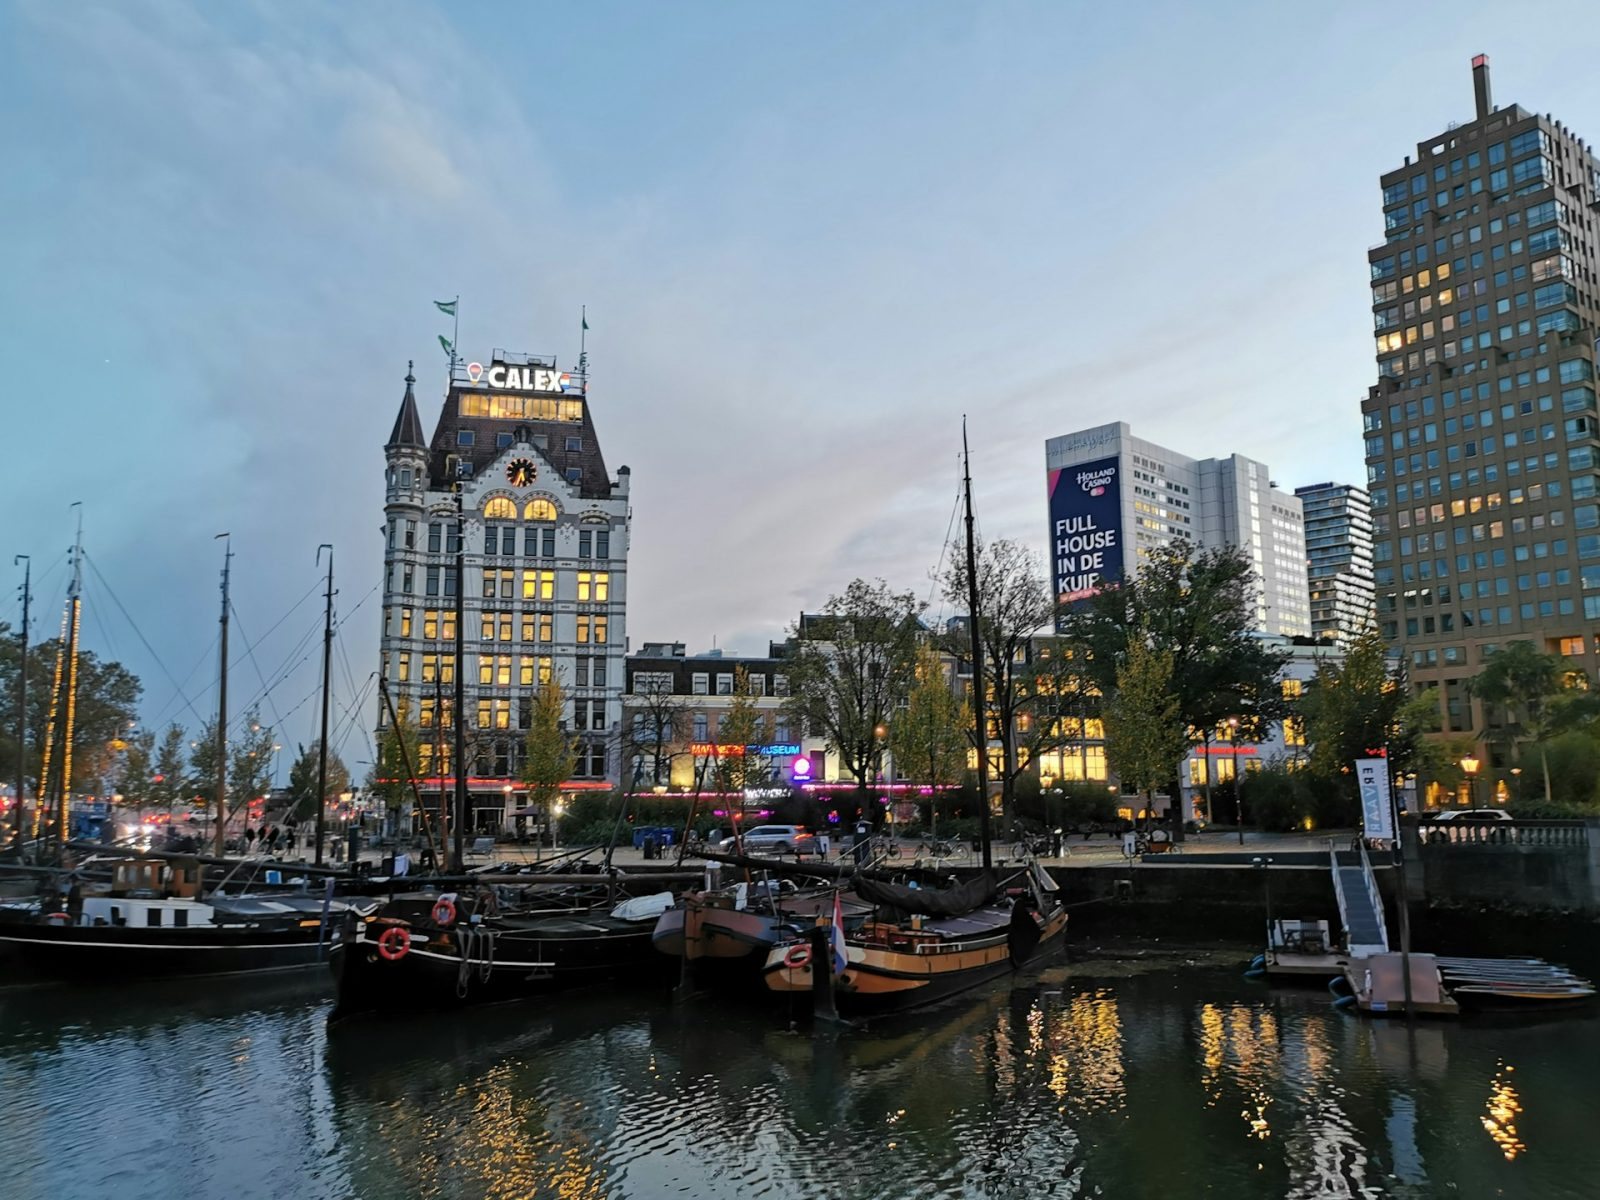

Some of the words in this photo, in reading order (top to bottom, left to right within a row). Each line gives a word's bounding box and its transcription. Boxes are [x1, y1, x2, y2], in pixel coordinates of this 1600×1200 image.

[488, 367, 562, 392] CALEX
[1076, 467, 1115, 484] HOLLAND
[1082, 477, 1111, 491] CASINO
[1056, 514, 1096, 536] FULL
[1057, 530, 1115, 555] HOUSE
[1058, 556, 1075, 574] IN
[1080, 552, 1104, 571] DE
[1059, 572, 1100, 593] KUIP
